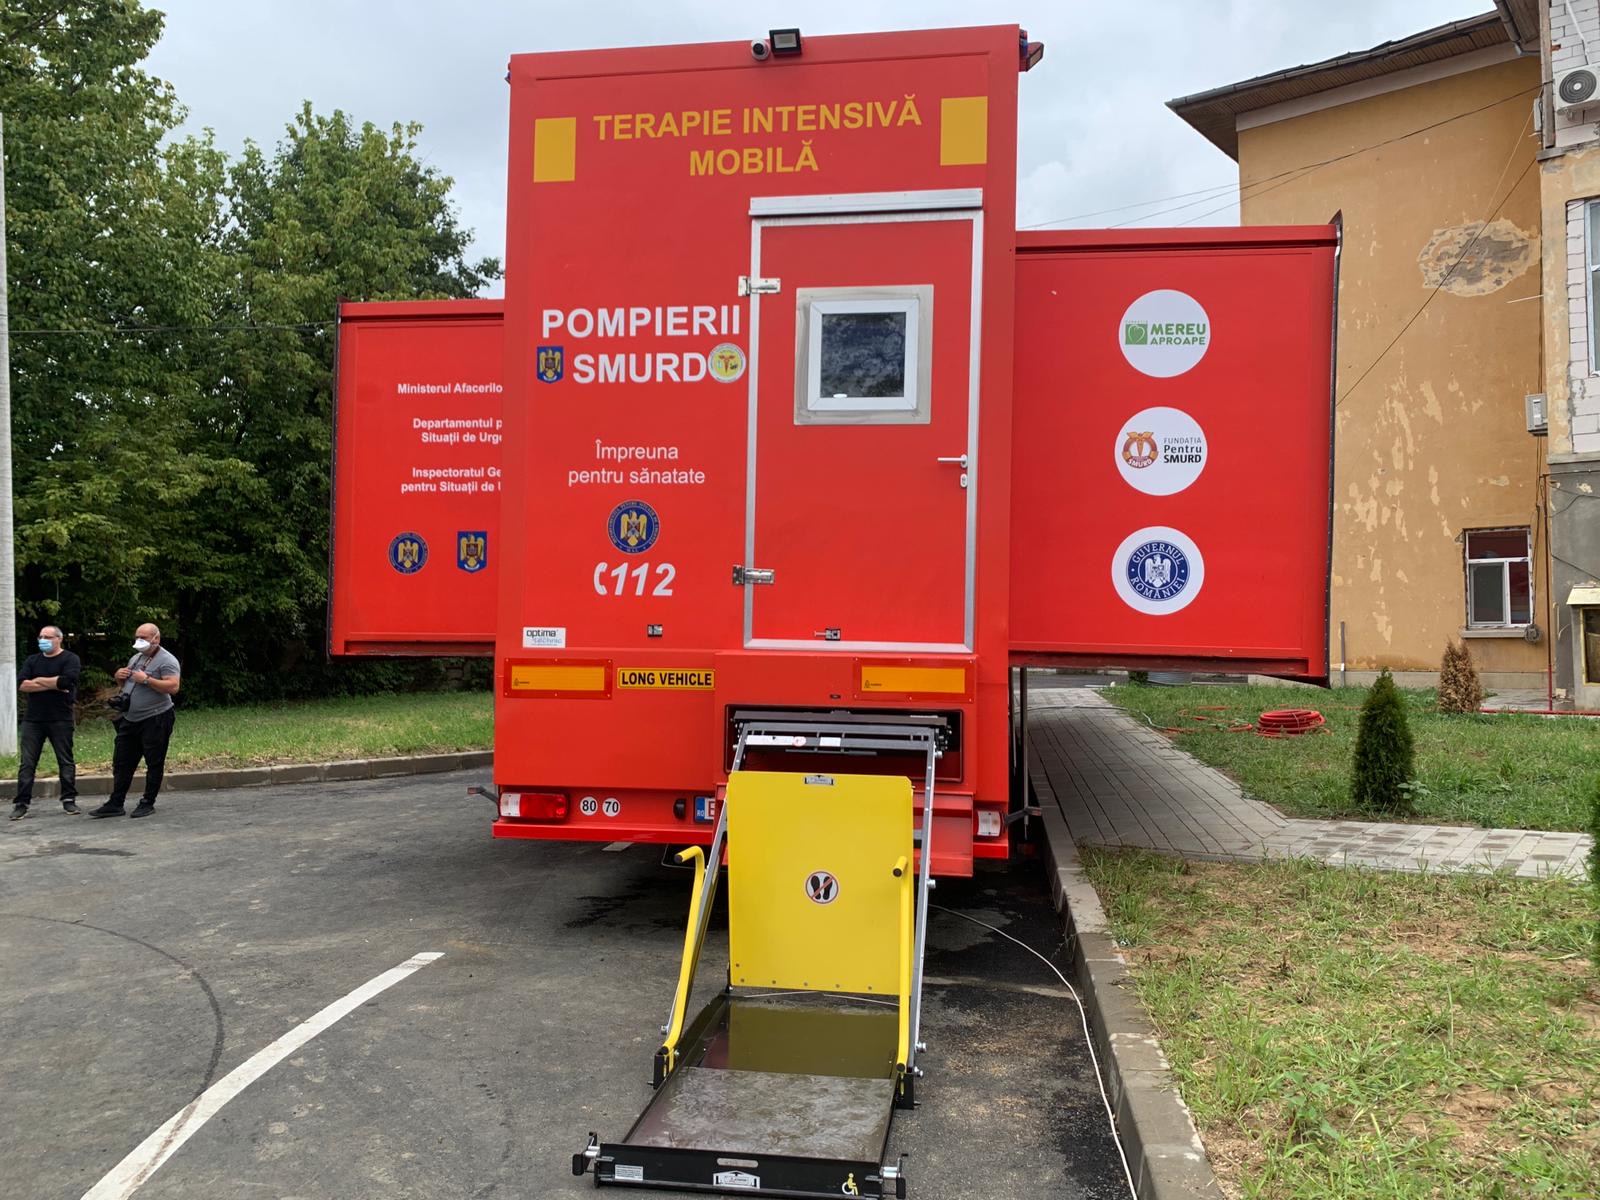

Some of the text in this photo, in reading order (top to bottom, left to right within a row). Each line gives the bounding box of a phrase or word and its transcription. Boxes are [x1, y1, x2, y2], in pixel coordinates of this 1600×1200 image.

[593, 94, 922, 141] TERAPIE INTENSIVĂ
[689, 140, 818, 177] MOBILĂ
[542, 305, 741, 339] POMPIERII
[1150, 323, 1206, 335] MEREU
[1150, 337, 1206, 345] APROAPE
[573, 352, 707, 384] SMURD
[397, 383, 451, 394] Ministerul
[413, 417, 493, 430] Departamentul
[462, 432, 476, 442] de
[595, 438, 679, 463] Împreuna
[1163, 444, 1202, 453] Pentru
[1163, 454, 1202, 463] SMURD
[412, 467, 484, 480] Inspectoratul
[568, 467, 705, 487] pentru sănatate
[401, 482, 437, 494] pentru
[481, 481, 494, 492] de
[1132, 543, 1184, 565] GUVERNUL
[611, 562, 676, 596] 112
[526, 629, 556, 638] optima
[621, 672, 712, 686] LONG VEHICLE
[582, 799, 597, 812] 80
[605, 801, 619, 813] 70
